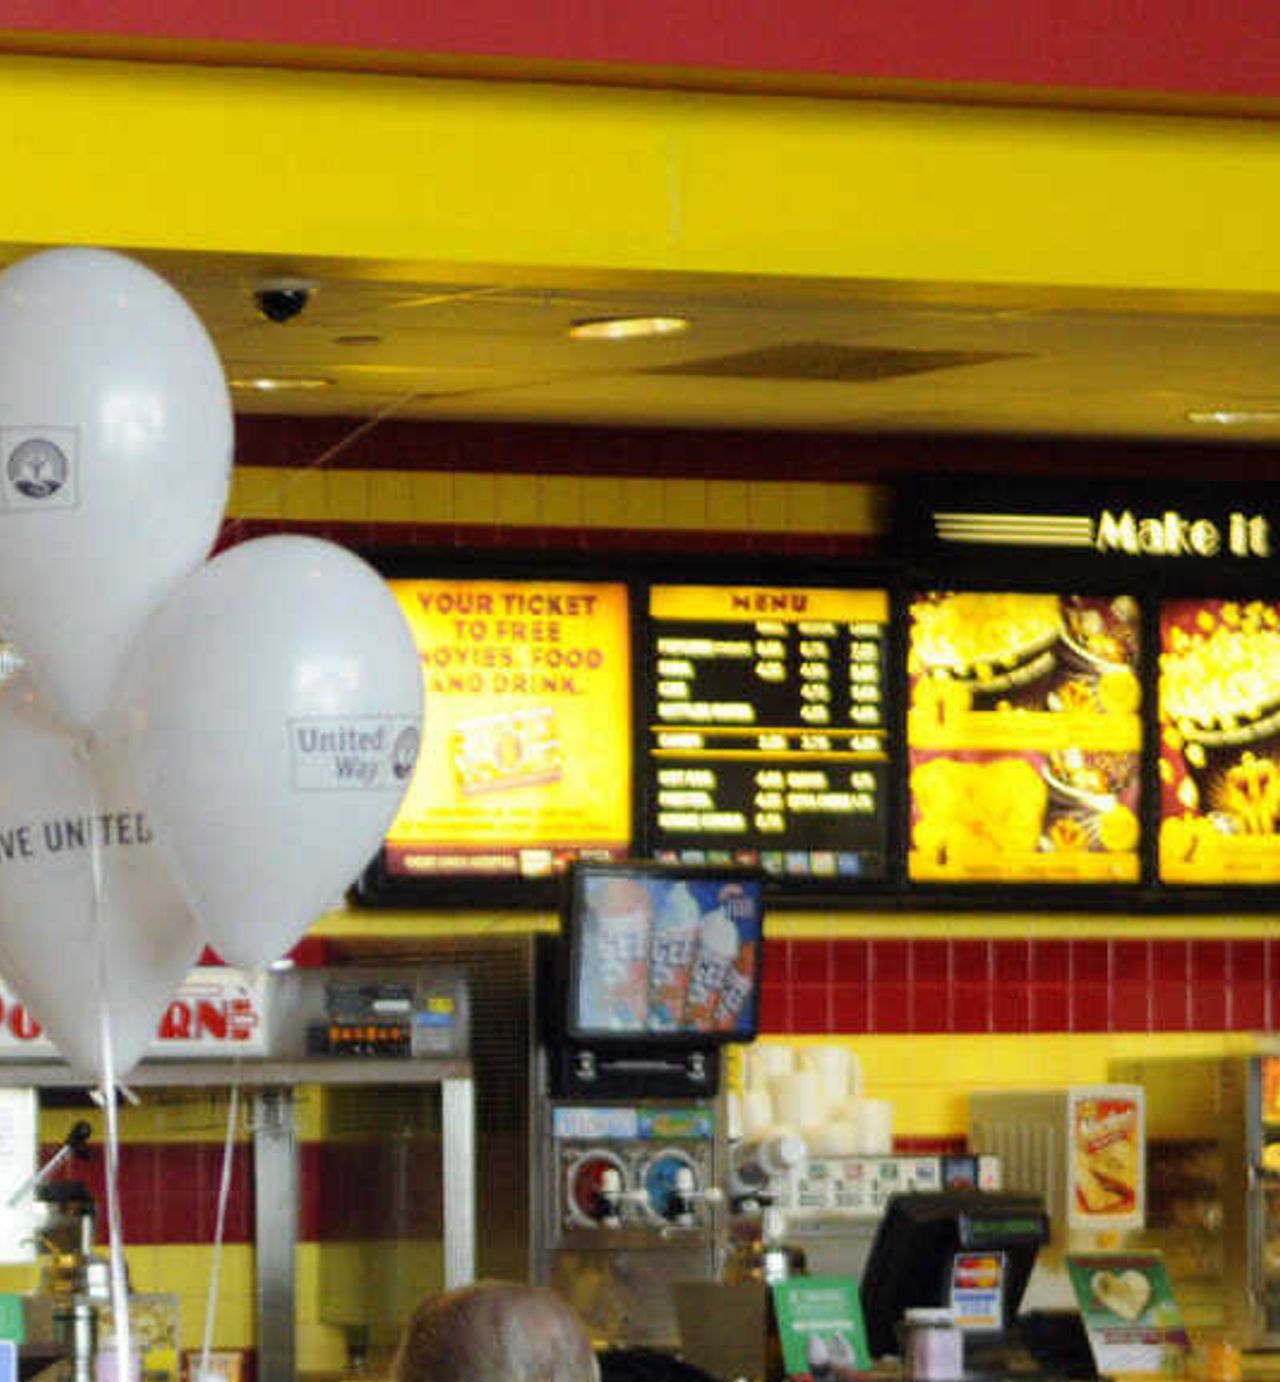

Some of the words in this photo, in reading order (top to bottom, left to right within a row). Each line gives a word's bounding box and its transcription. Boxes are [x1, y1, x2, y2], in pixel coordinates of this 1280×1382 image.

[1096, 510, 1220, 557] Make
[417, 593, 494, 616] YOUR
[502, 595, 598, 617] TICKET
[731, 594, 809, 613] MENU
[455, 620, 488, 641] TO
[495, 621, 562, 642] FREE
[531, 648, 604, 669] FOOD
[433, 672, 484, 694] AND
[297, 724, 386, 753] United
